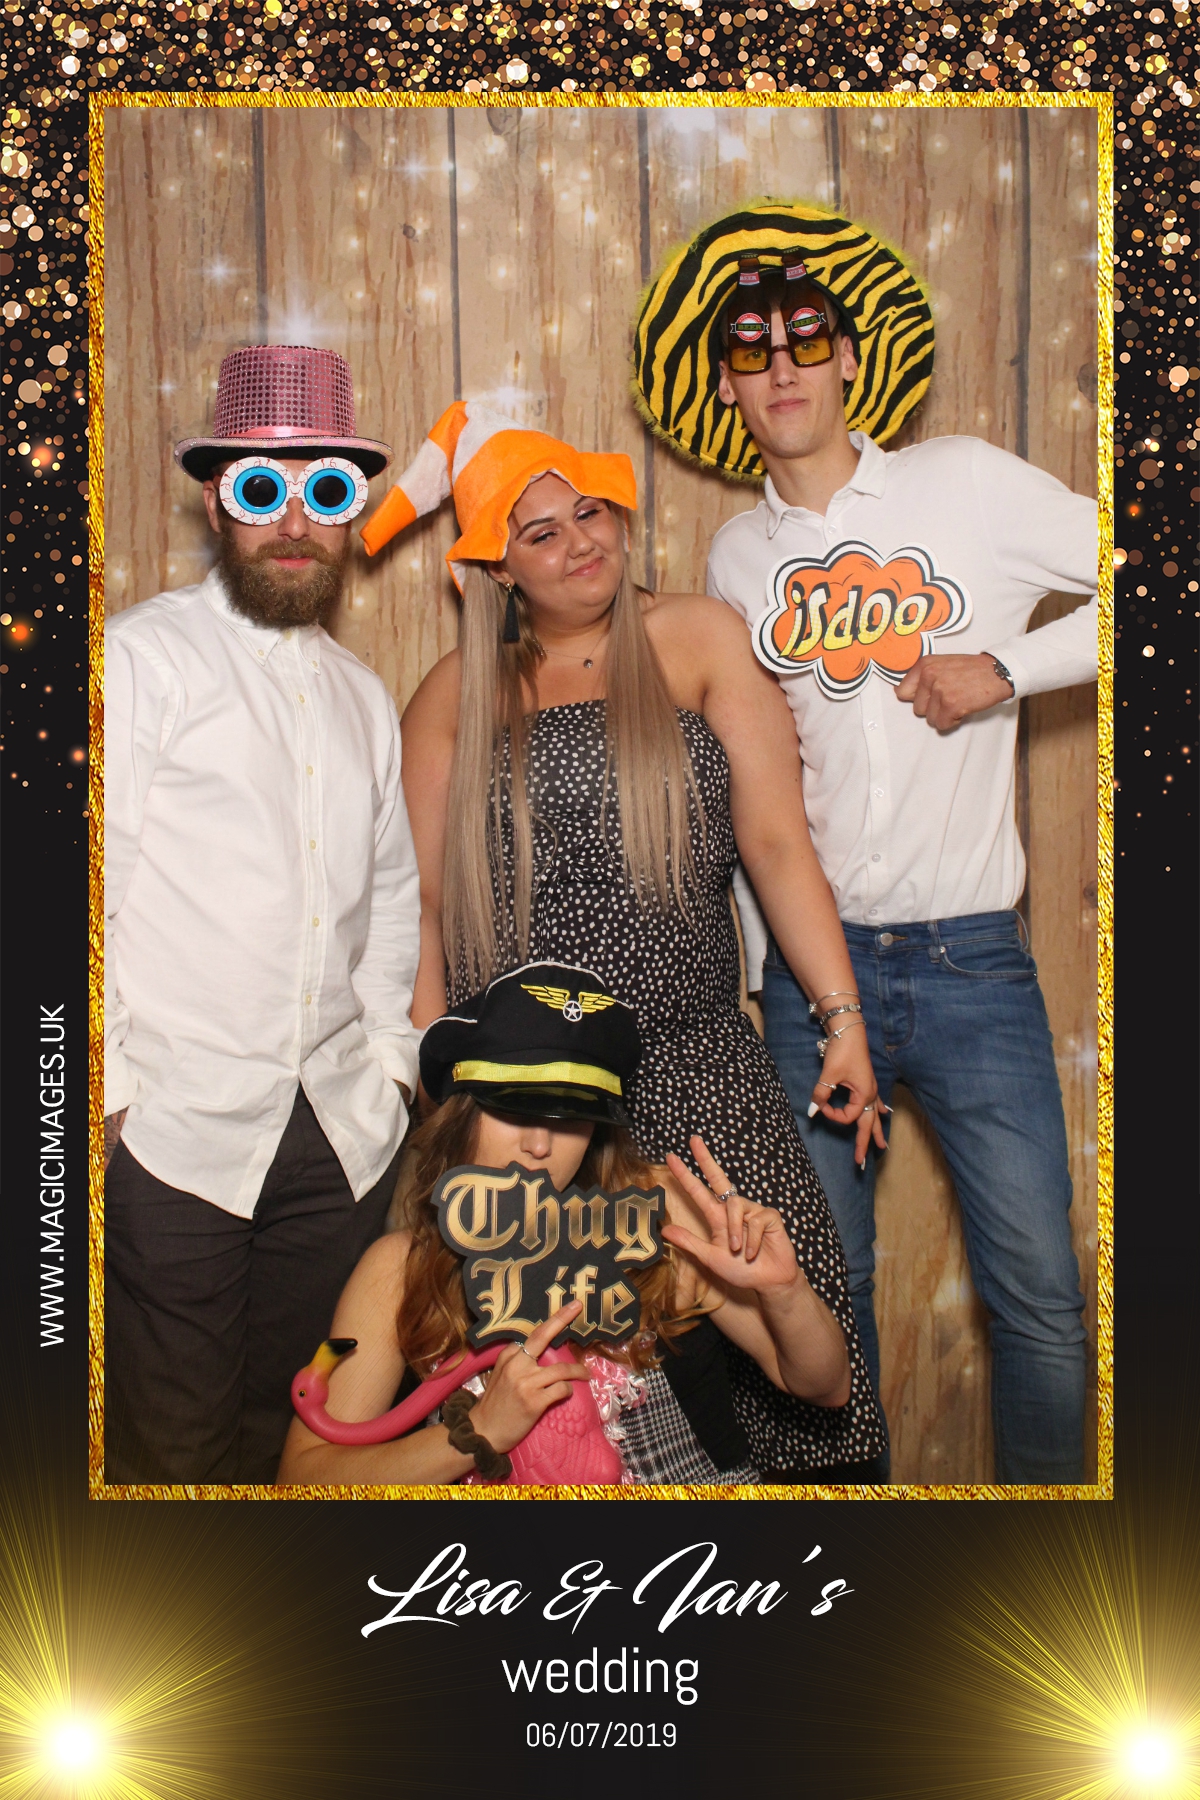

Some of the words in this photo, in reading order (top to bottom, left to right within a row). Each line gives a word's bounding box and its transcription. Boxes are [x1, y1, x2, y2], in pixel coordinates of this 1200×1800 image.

[793, 316, 819, 329] BEER
[440, 1170, 660, 1262] Thug
[470, 1256, 636, 1340] Life
